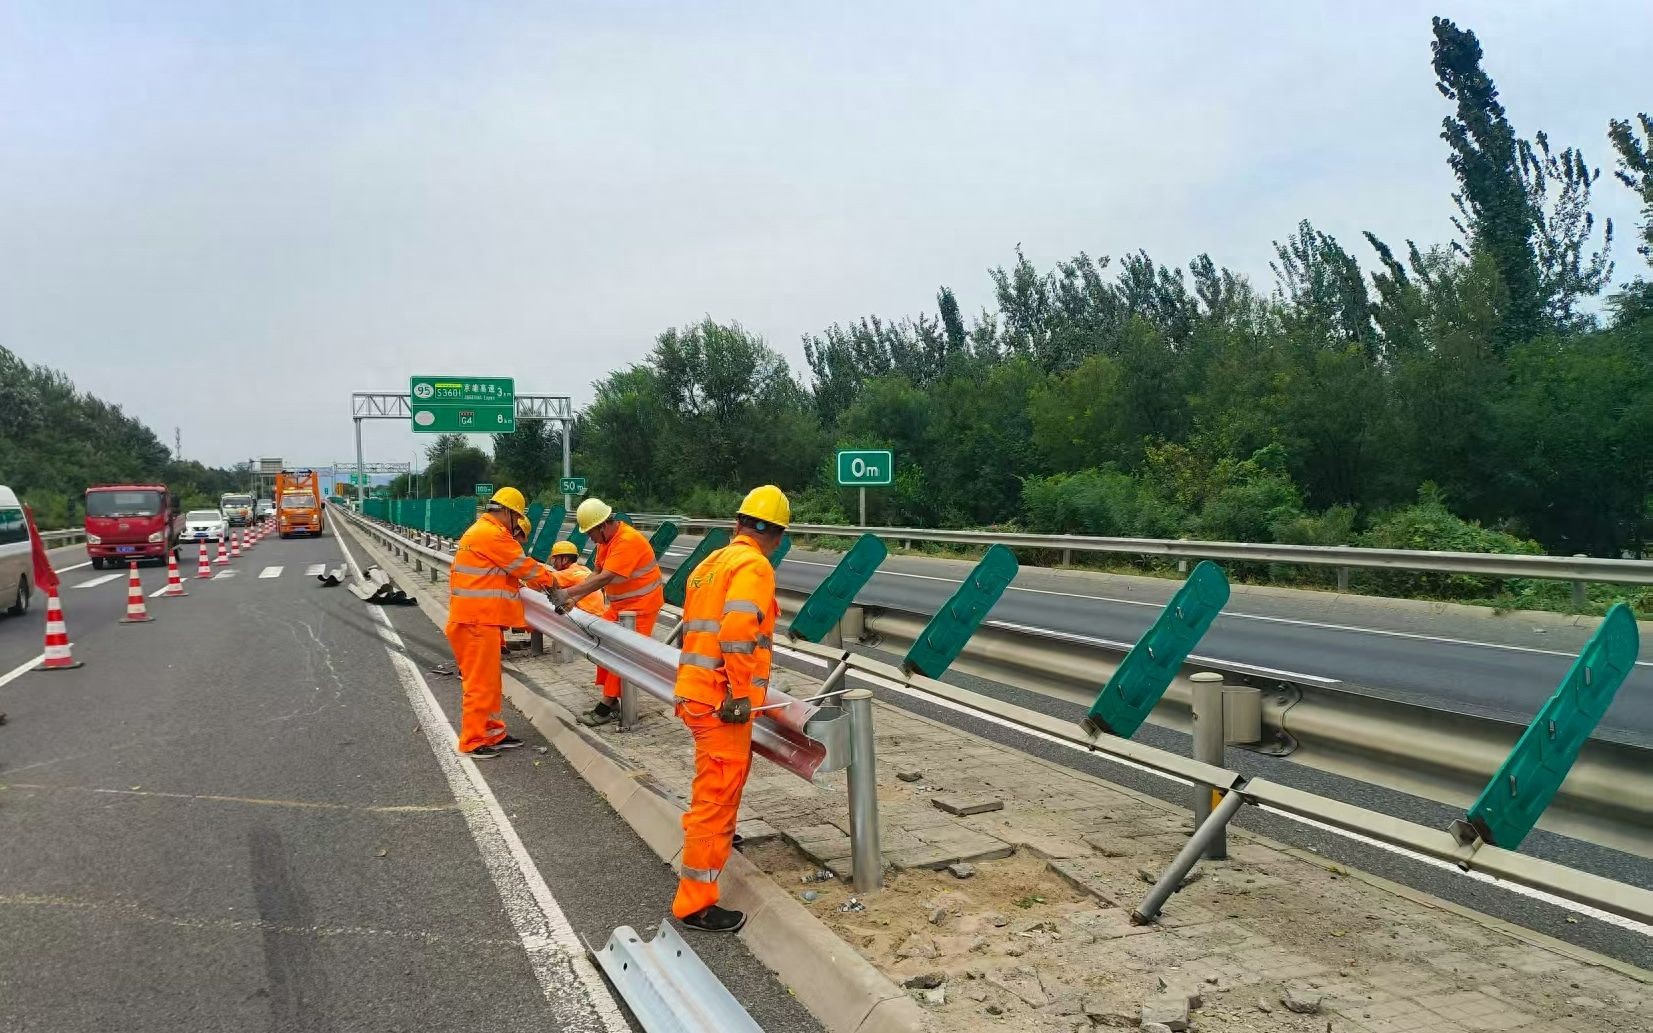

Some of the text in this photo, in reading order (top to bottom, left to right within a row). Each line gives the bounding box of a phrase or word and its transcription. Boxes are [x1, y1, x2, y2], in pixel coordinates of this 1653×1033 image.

[418, 386, 431, 396] 95
[437, 388, 461, 397] S3601
[461, 417, 472, 425] G4
[851, 457, 879, 478] 0m
